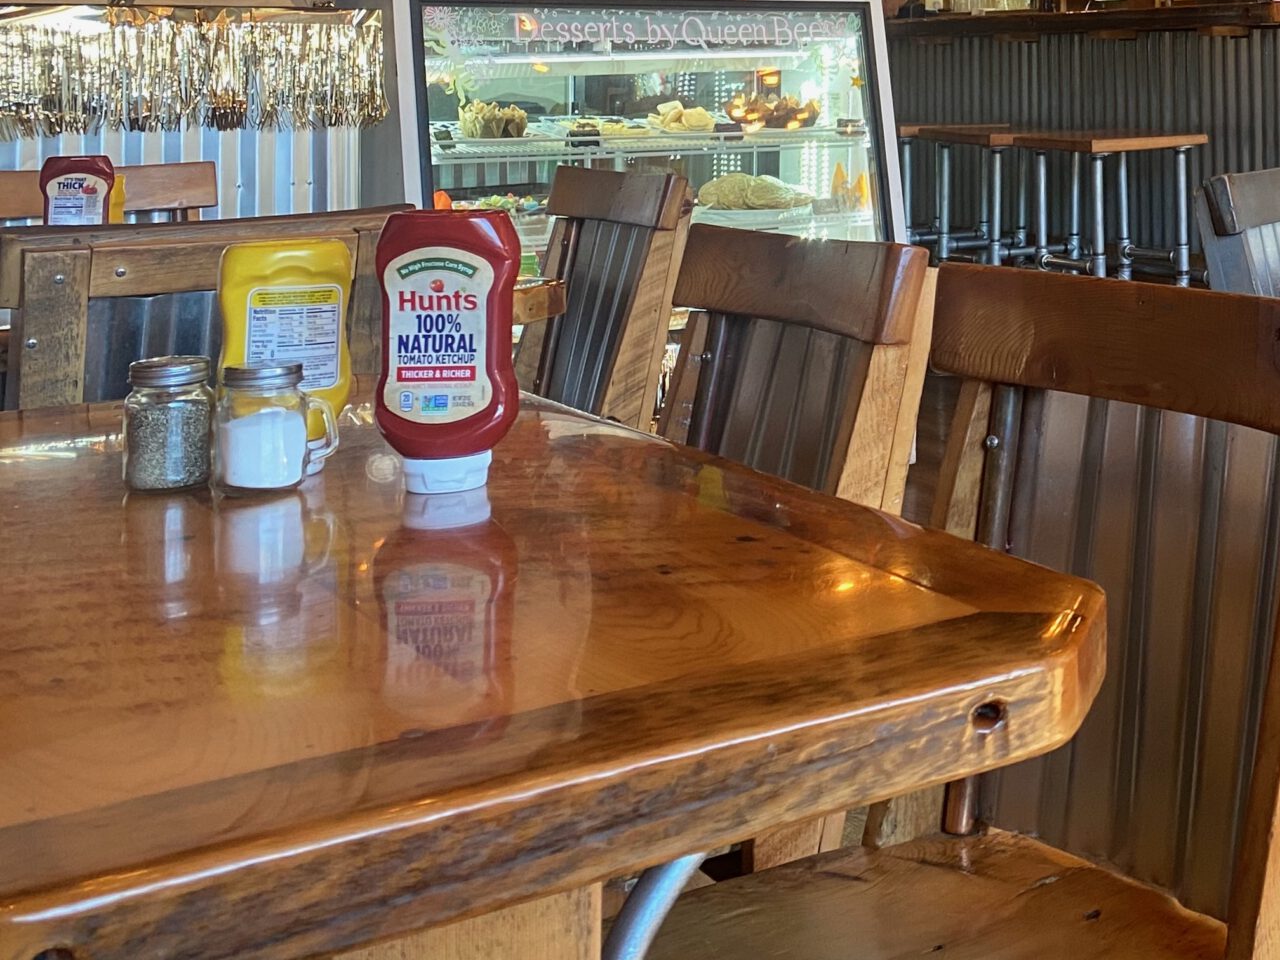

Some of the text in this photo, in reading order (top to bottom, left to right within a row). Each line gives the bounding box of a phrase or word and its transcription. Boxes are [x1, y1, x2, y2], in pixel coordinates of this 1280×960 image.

[513, 12, 822, 52] Desserts by Queen Bee
[57, 182, 84, 190] THICK
[416, 314, 462, 333] 100%
[397, 334, 477, 353] NATURAL
[397, 354, 475, 365] TOMATO KETCHUP
[401, 370, 434, 378] THICKER
[435, 370, 441, 378] &
